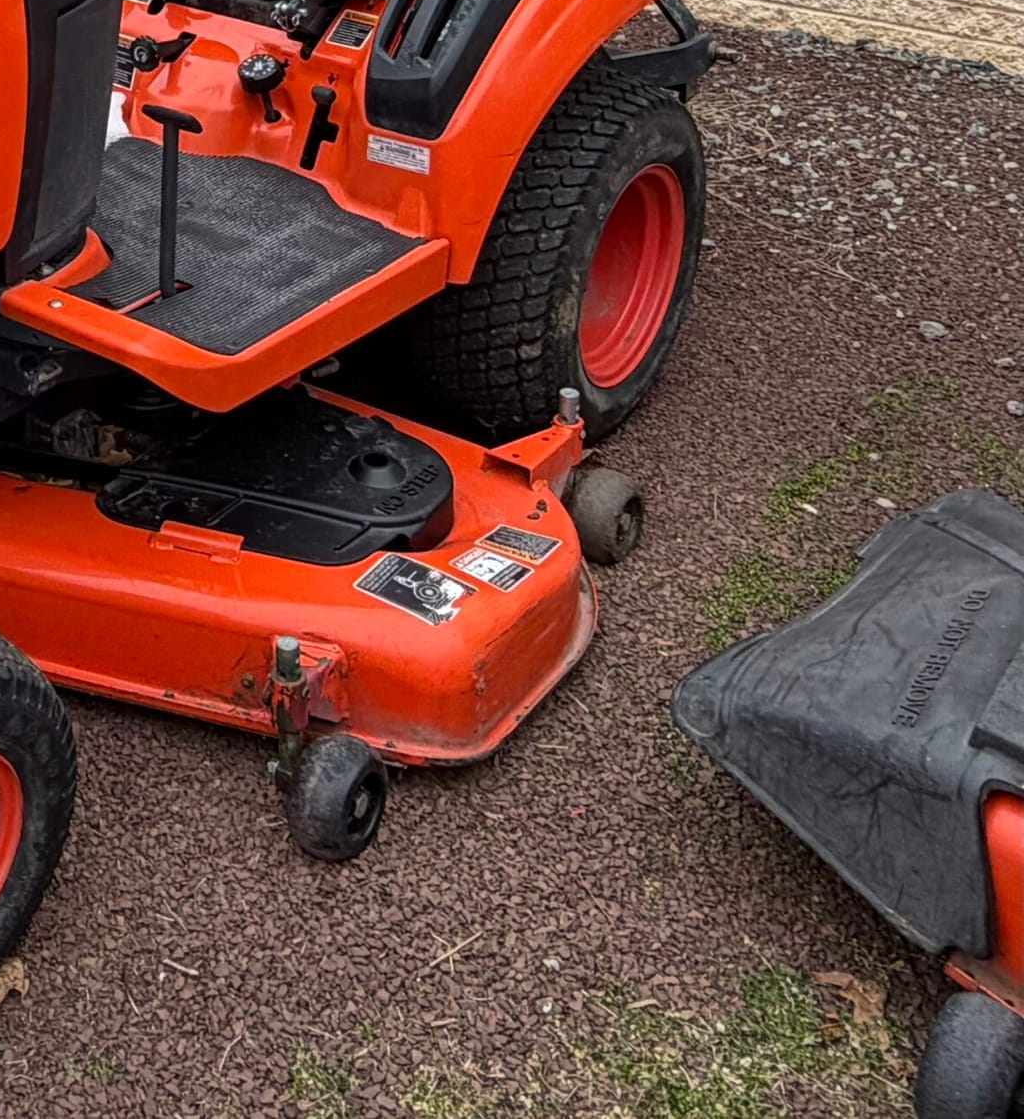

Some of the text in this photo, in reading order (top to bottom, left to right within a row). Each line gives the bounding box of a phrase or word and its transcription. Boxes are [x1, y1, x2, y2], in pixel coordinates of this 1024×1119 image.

[375, 464, 438, 515] NO STEP
[890, 589, 990, 729] DO NOT REMOVE
